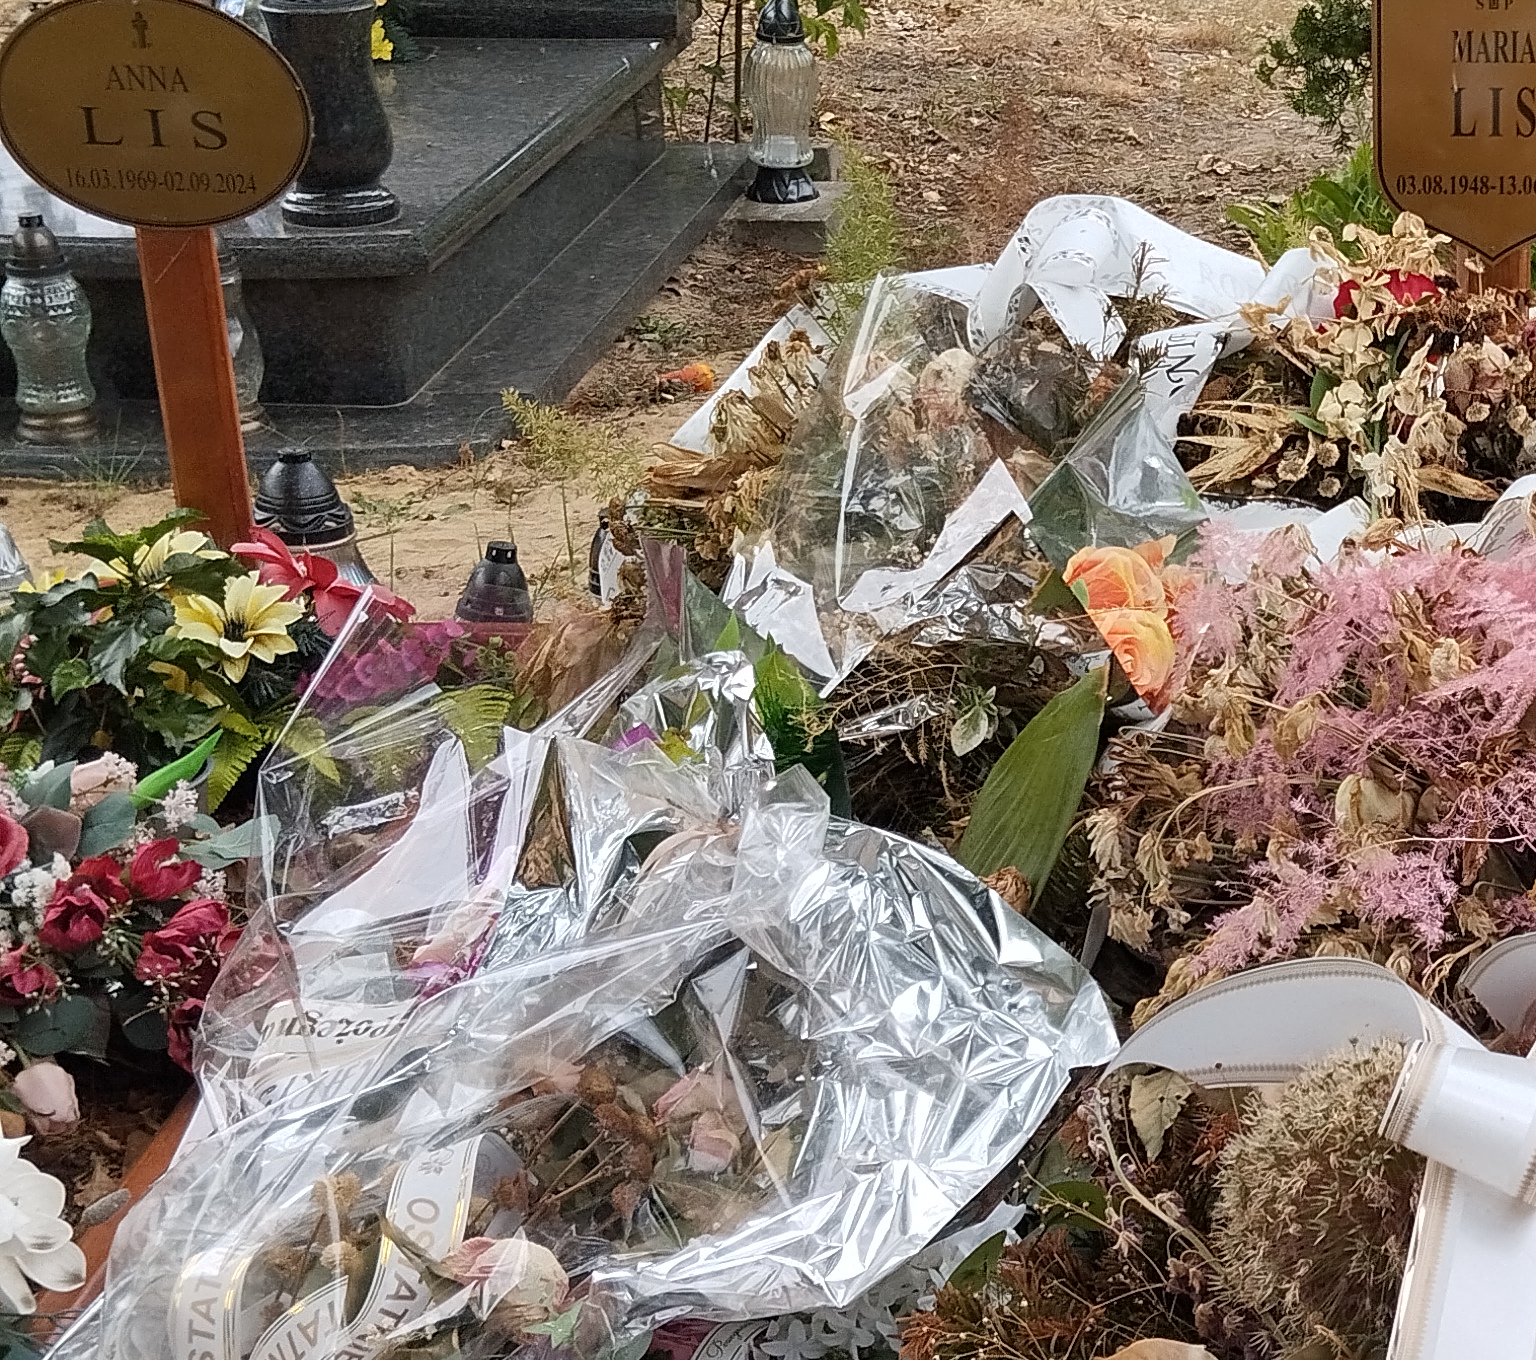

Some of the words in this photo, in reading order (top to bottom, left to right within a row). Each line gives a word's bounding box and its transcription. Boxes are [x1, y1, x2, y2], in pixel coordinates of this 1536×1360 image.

[1450, 30, 1536, 64] MARIA
[105, 64, 190, 92] ANNA
[78, 106, 228, 150] LIS
[1450, 86, 1536, 138] LIS
